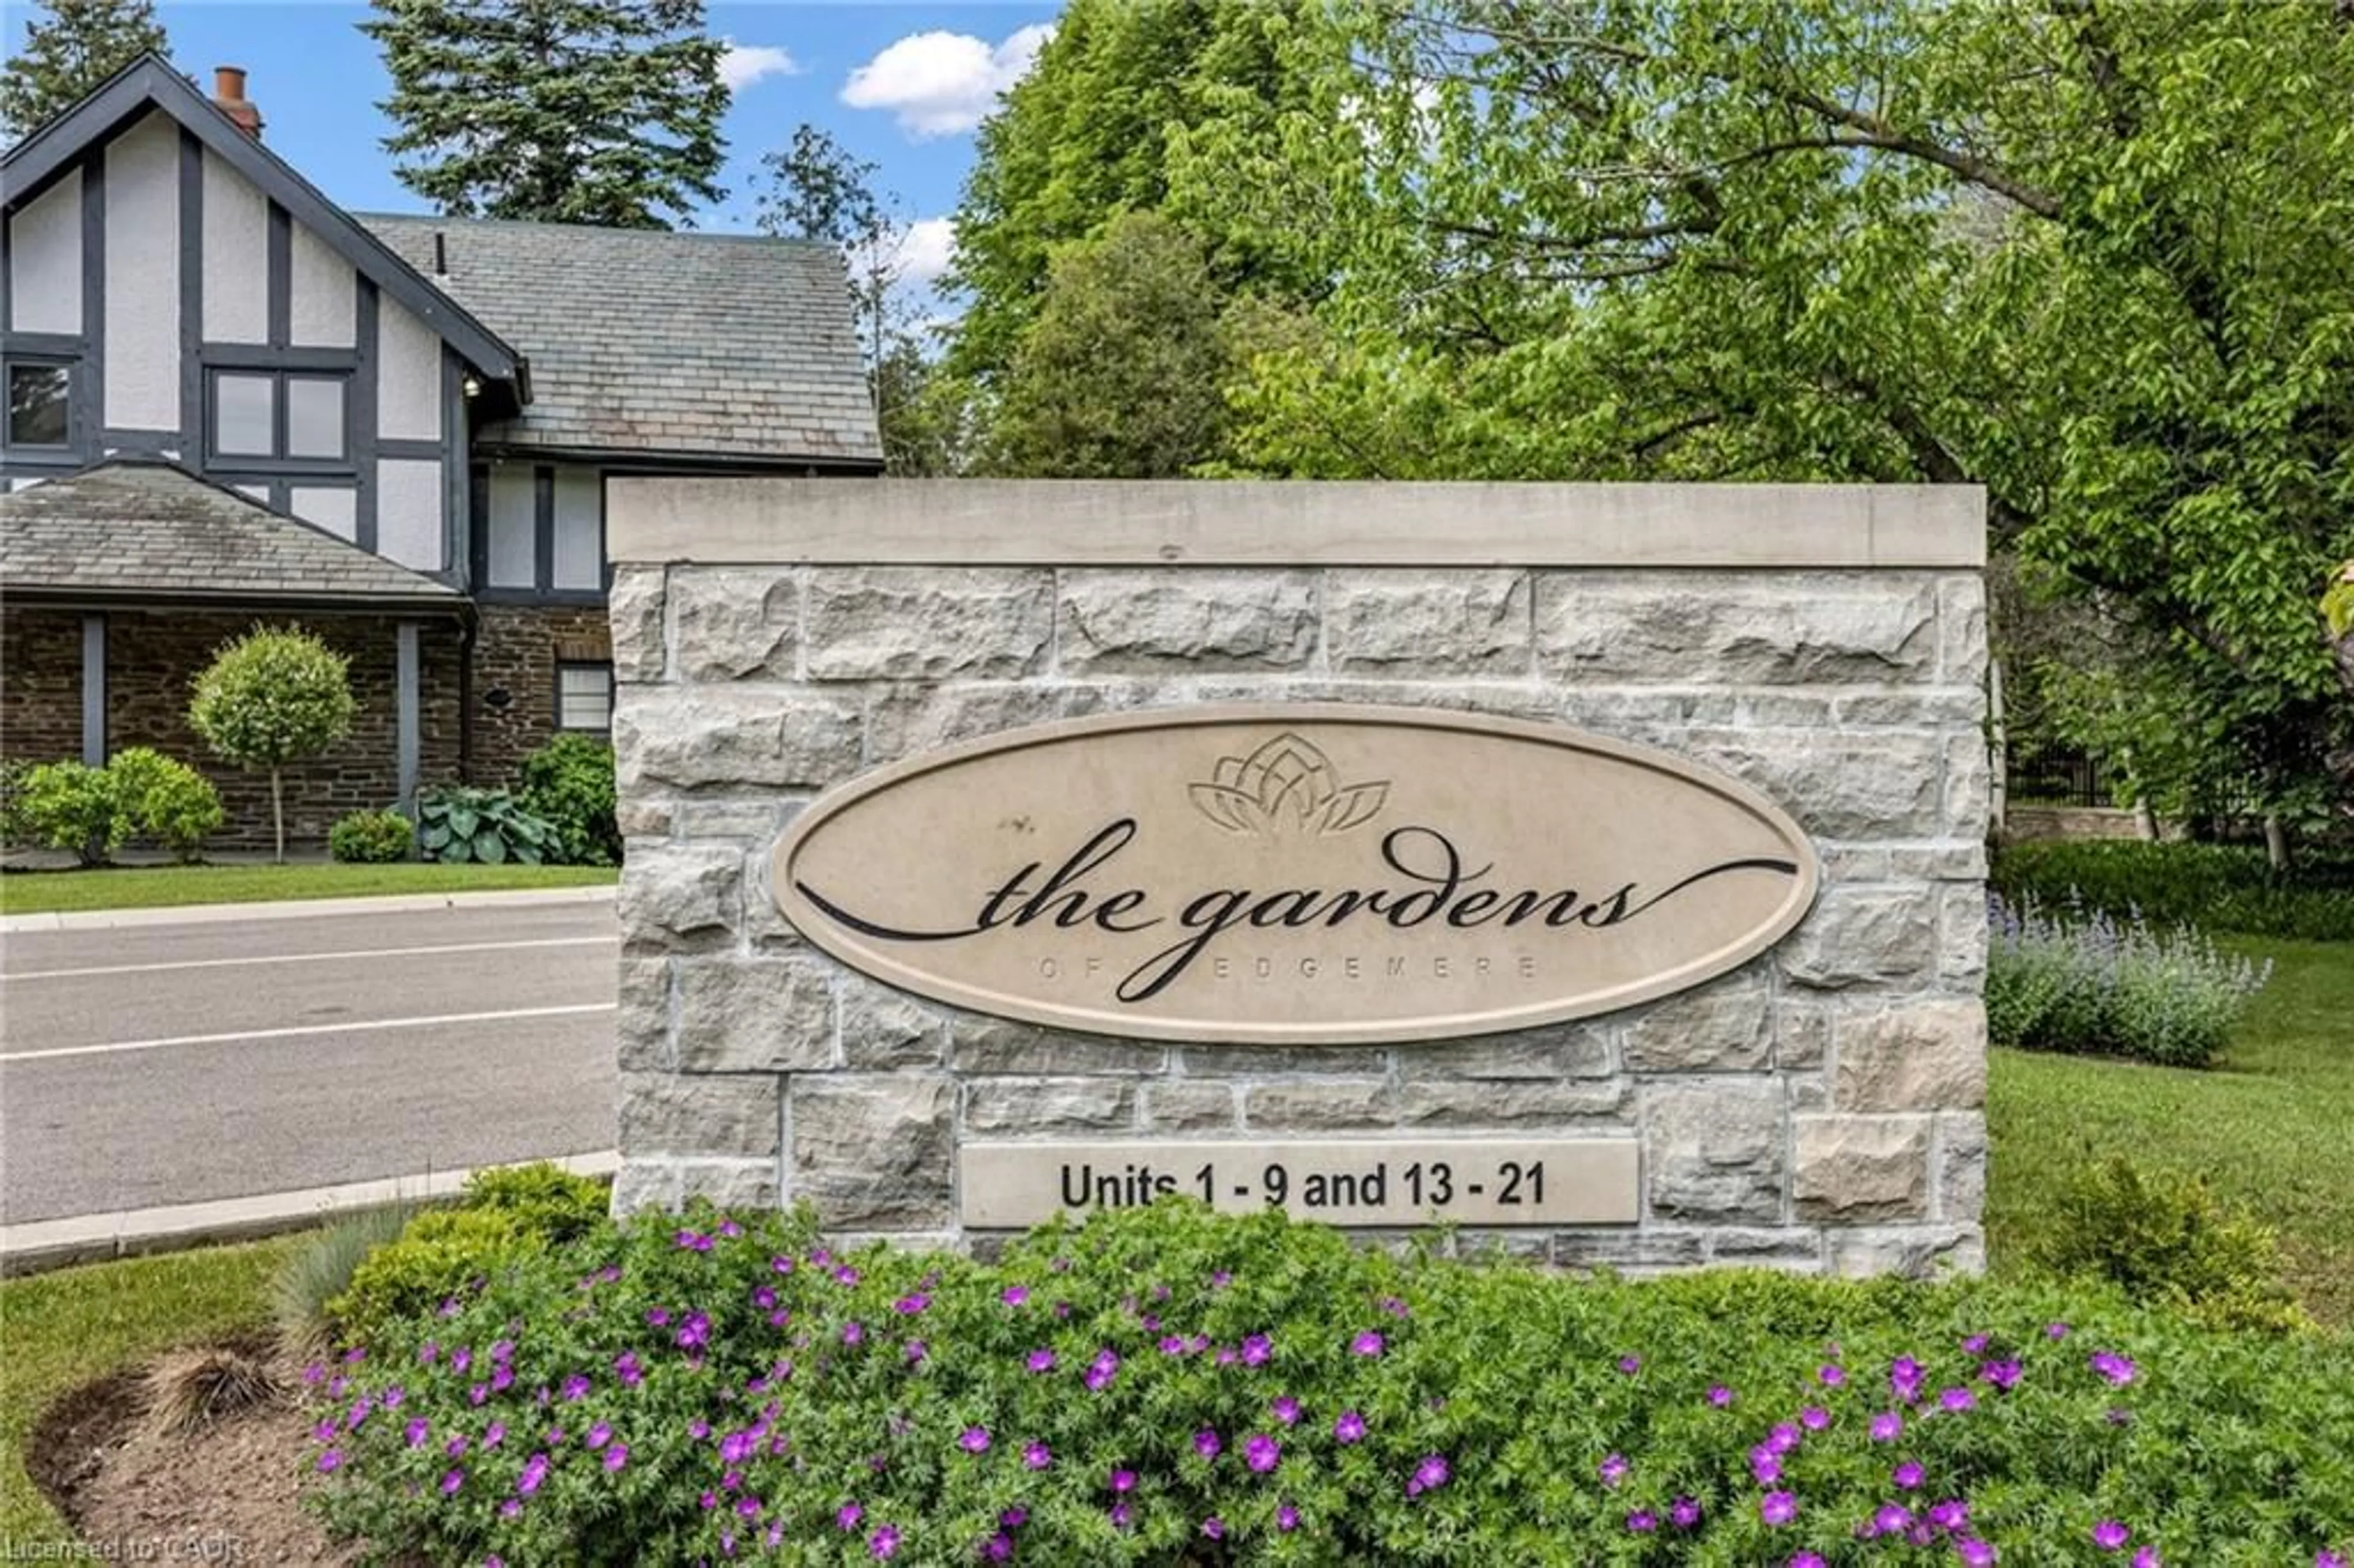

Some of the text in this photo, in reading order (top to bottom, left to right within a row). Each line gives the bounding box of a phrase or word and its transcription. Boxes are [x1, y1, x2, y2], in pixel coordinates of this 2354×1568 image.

[1116, 827, 1797, 1003] gardens
[1040, 957, 1536, 979] OF EDGEMERE
[1062, 1161, 1544, 1208] Units 1 - 9 and 13 - 21
